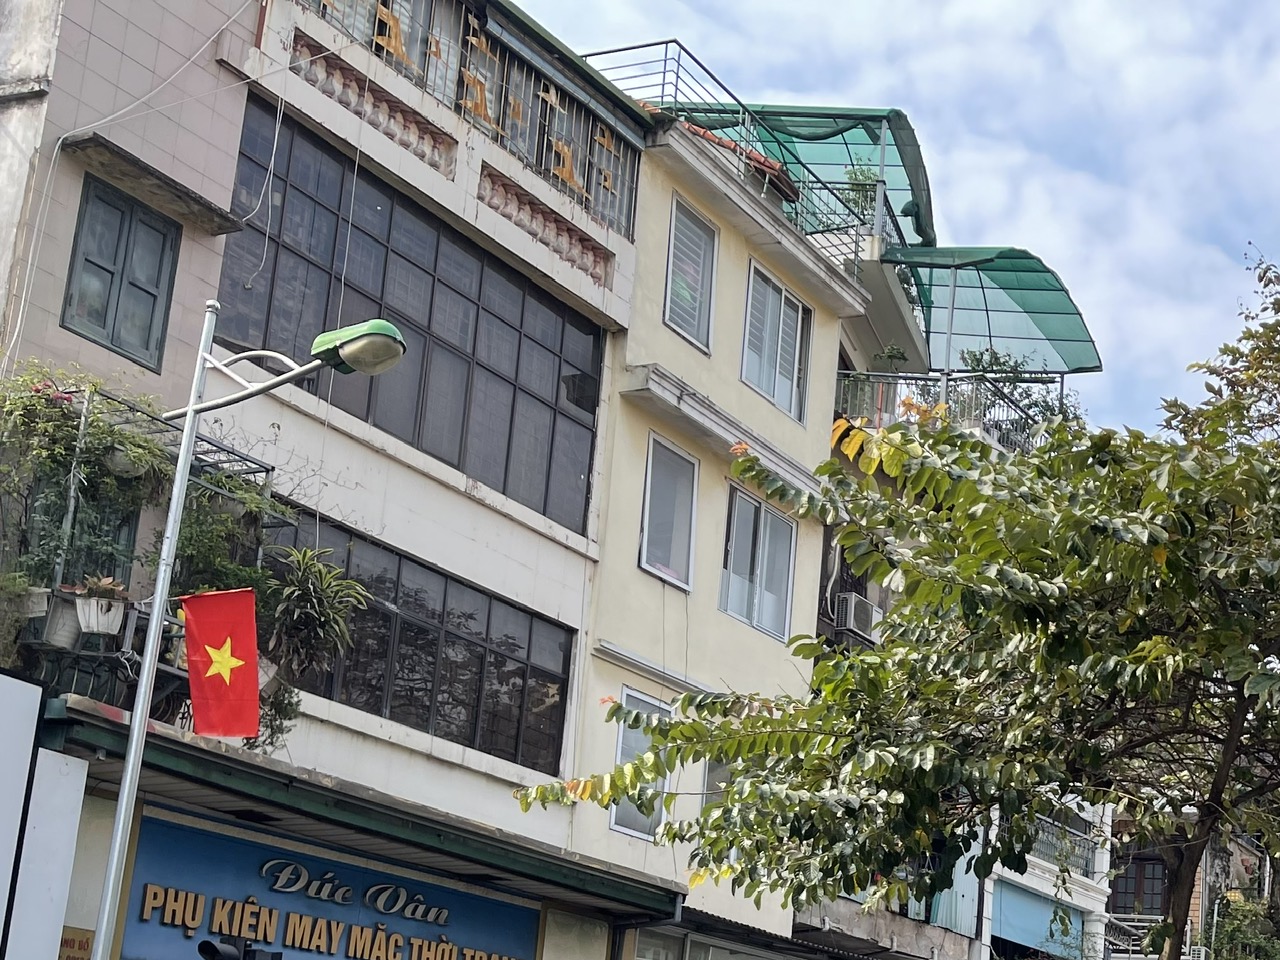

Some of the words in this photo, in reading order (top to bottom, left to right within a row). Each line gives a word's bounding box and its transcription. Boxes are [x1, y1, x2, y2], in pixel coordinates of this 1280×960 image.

[142, 883, 206, 937] PHỤ
[285, 912, 345, 954] MAY
[261, 859, 353, 904] Đức
[364, 884, 450, 925] Vân
